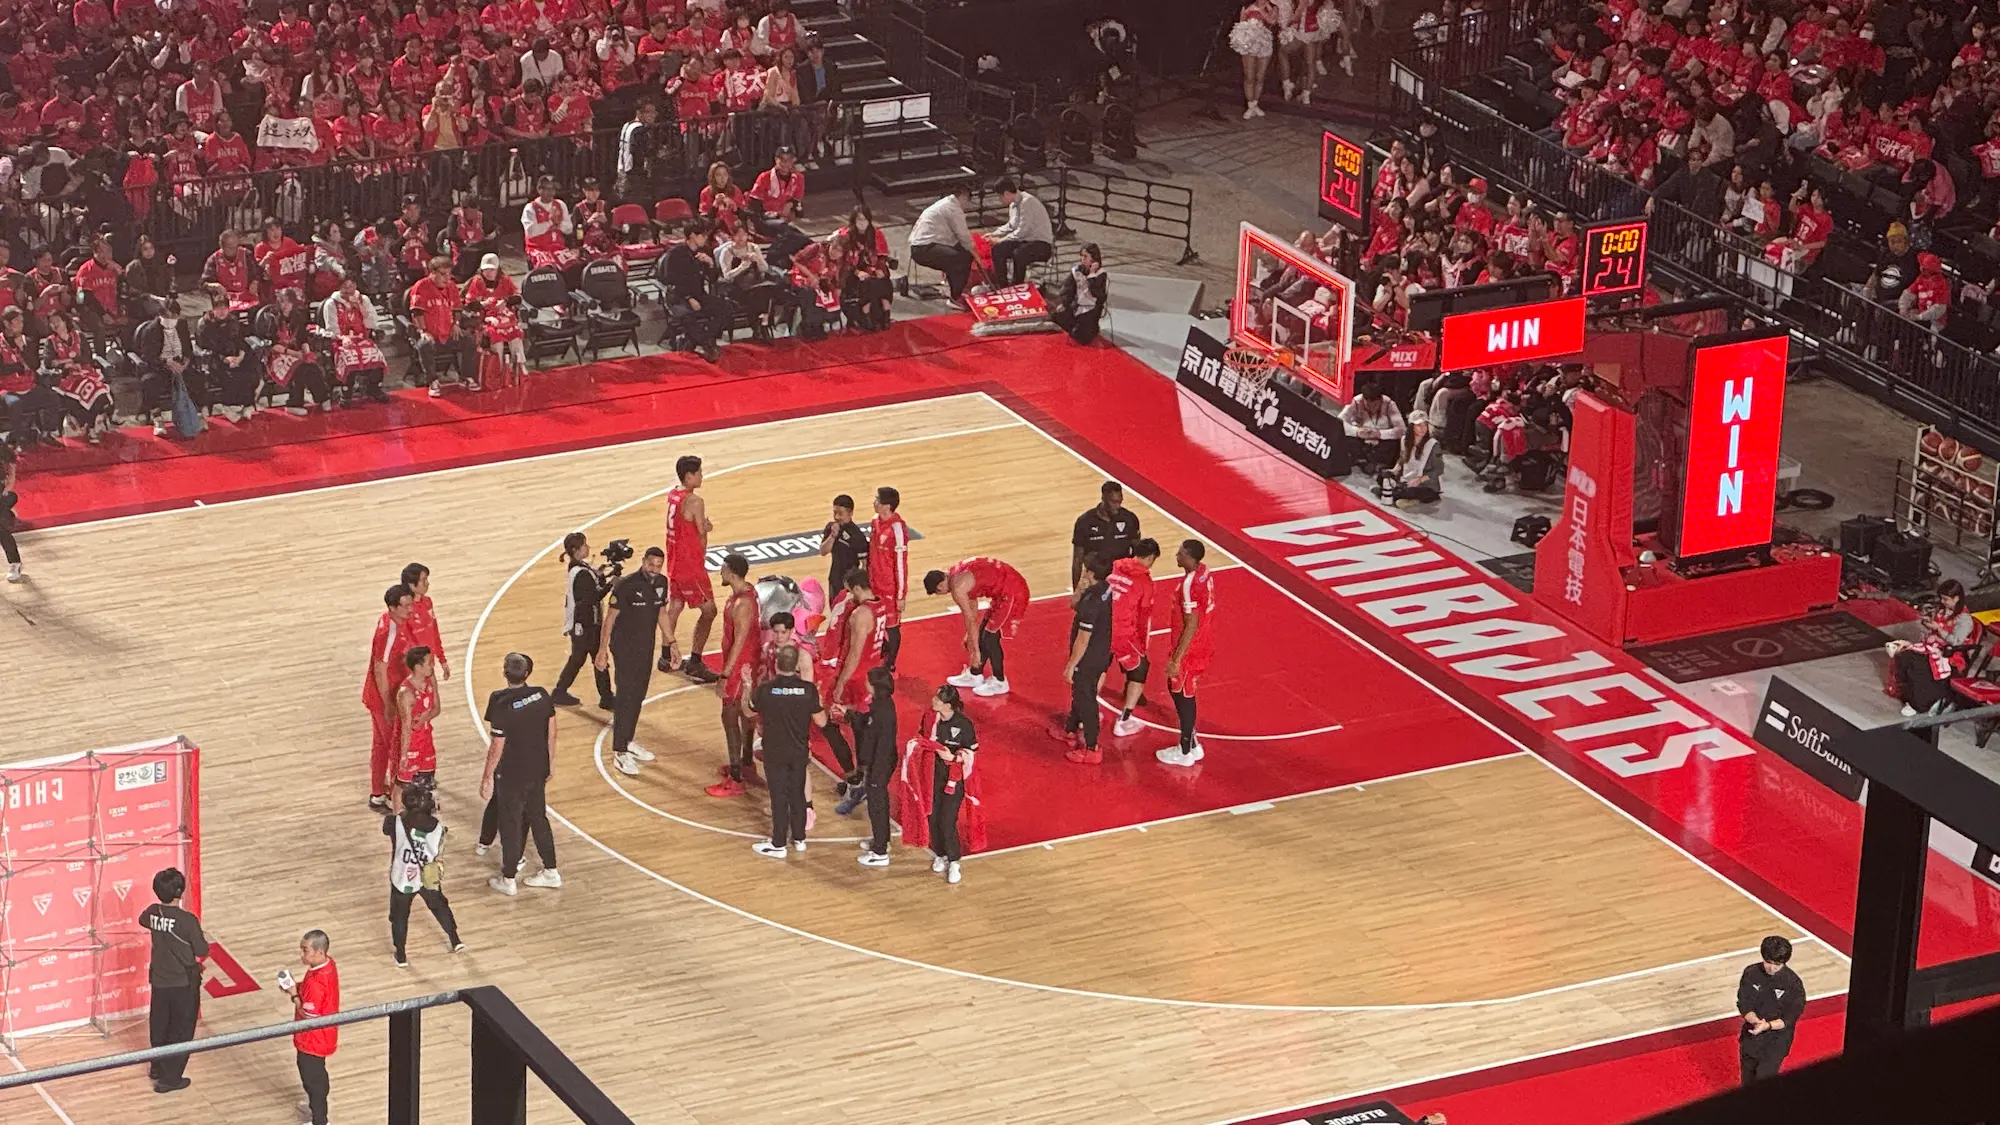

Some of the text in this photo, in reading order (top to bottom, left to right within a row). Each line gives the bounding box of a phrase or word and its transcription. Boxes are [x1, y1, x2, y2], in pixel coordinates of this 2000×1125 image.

[1333, 143, 1361, 176] 0:00
[1329, 168, 1357, 209] 24
[1601, 229, 1640, 255] 0:00
[1593, 256, 1633, 290] 24
[1487, 317, 1541, 353] WIN
[1389, 350, 1418, 363] MIXI
[1181, 344, 1257, 410] 京成電鉄
[1281, 416, 1332, 460] ちばぎん
[1717, 376, 1754, 517] WIN
[1564, 496, 1588, 607] 日本電技
